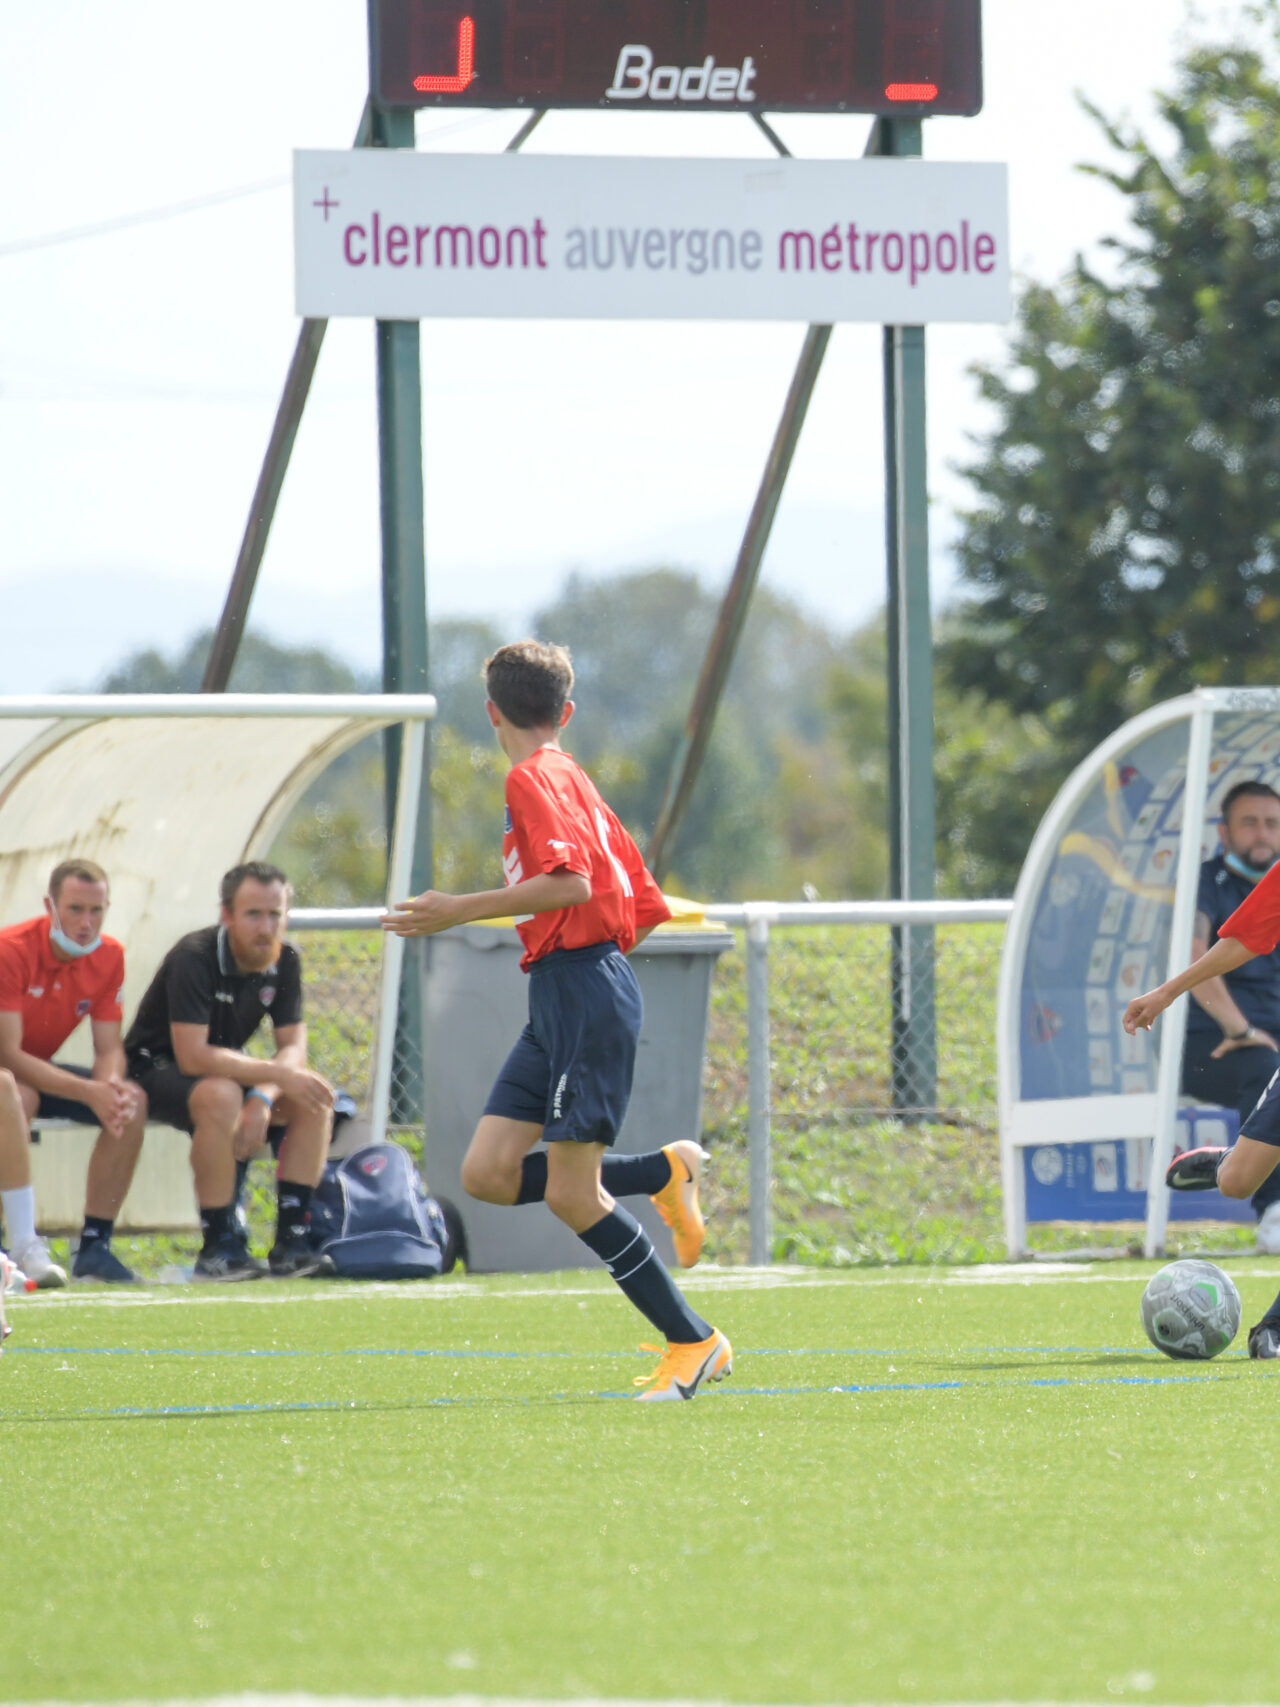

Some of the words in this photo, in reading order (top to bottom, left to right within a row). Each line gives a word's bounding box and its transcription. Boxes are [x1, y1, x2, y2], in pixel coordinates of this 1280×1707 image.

[604, 43, 757, 102] Bodet
[343, 210, 548, 269] clermont
[564, 225, 763, 276] auvergne
[778, 219, 996, 288] métropole
[1169, 1292, 1206, 1331] uhlsport
